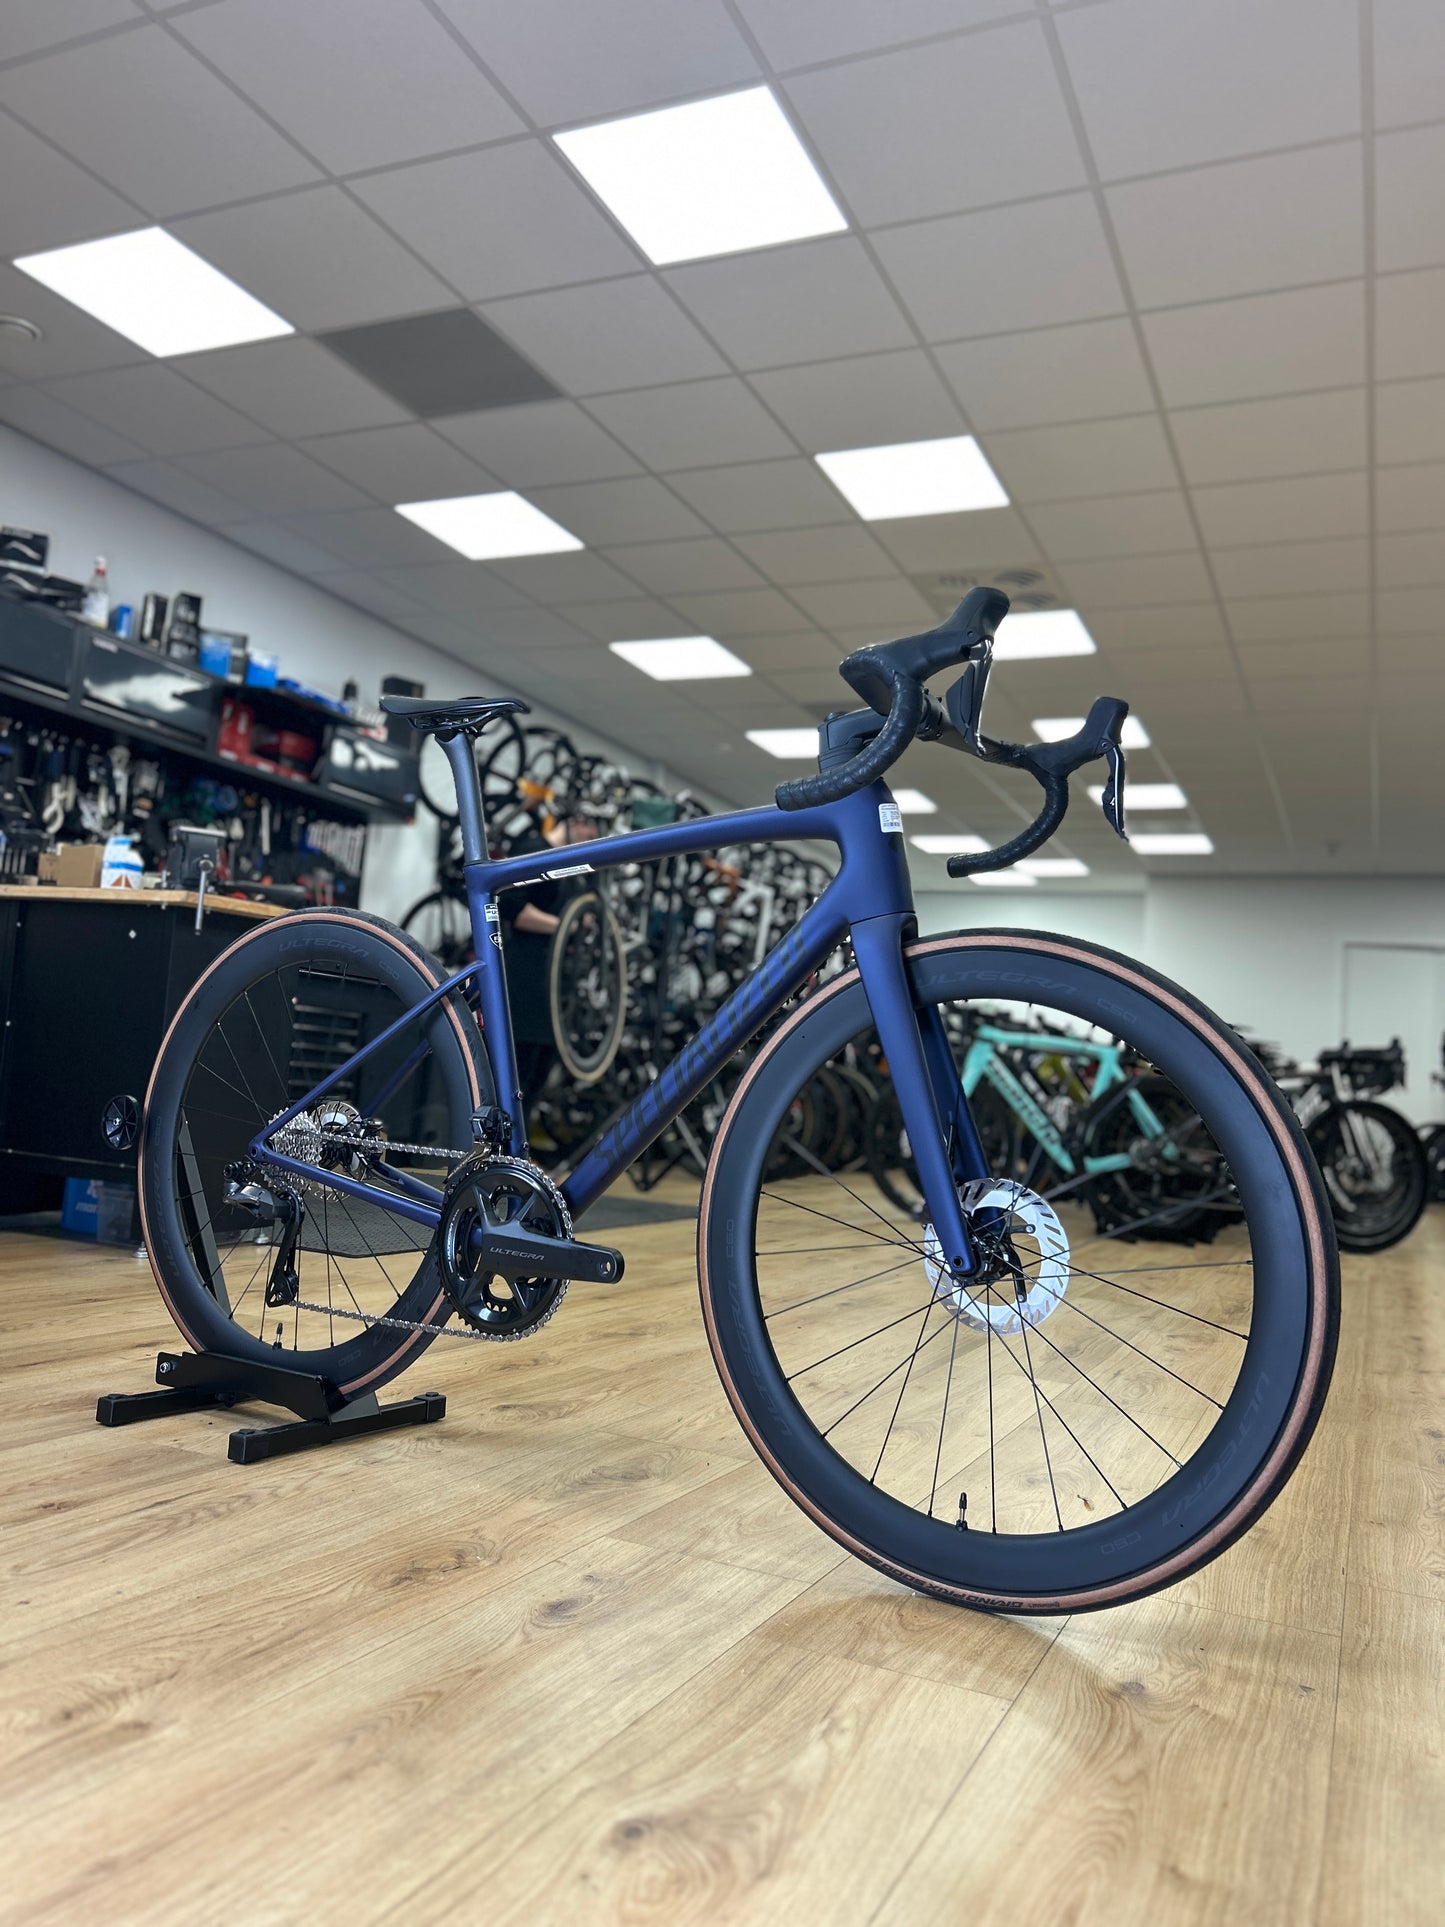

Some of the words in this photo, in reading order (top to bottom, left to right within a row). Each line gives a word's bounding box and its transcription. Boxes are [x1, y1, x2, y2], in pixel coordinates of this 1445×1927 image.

[278, 937, 370, 958] ULTEGRA
[918, 969, 1080, 995] ULTEGRA
[596, 924, 807, 1166] SPECIALIZED
[489, 1246, 545, 1261] ULTEGRA
[728, 1280, 793, 1436] ULTEGRA
[1161, 1371, 1270, 1528] ULTEGRA
[926, 1582, 966, 1600] PRIX
[966, 1594, 1023, 1609] GRAND
